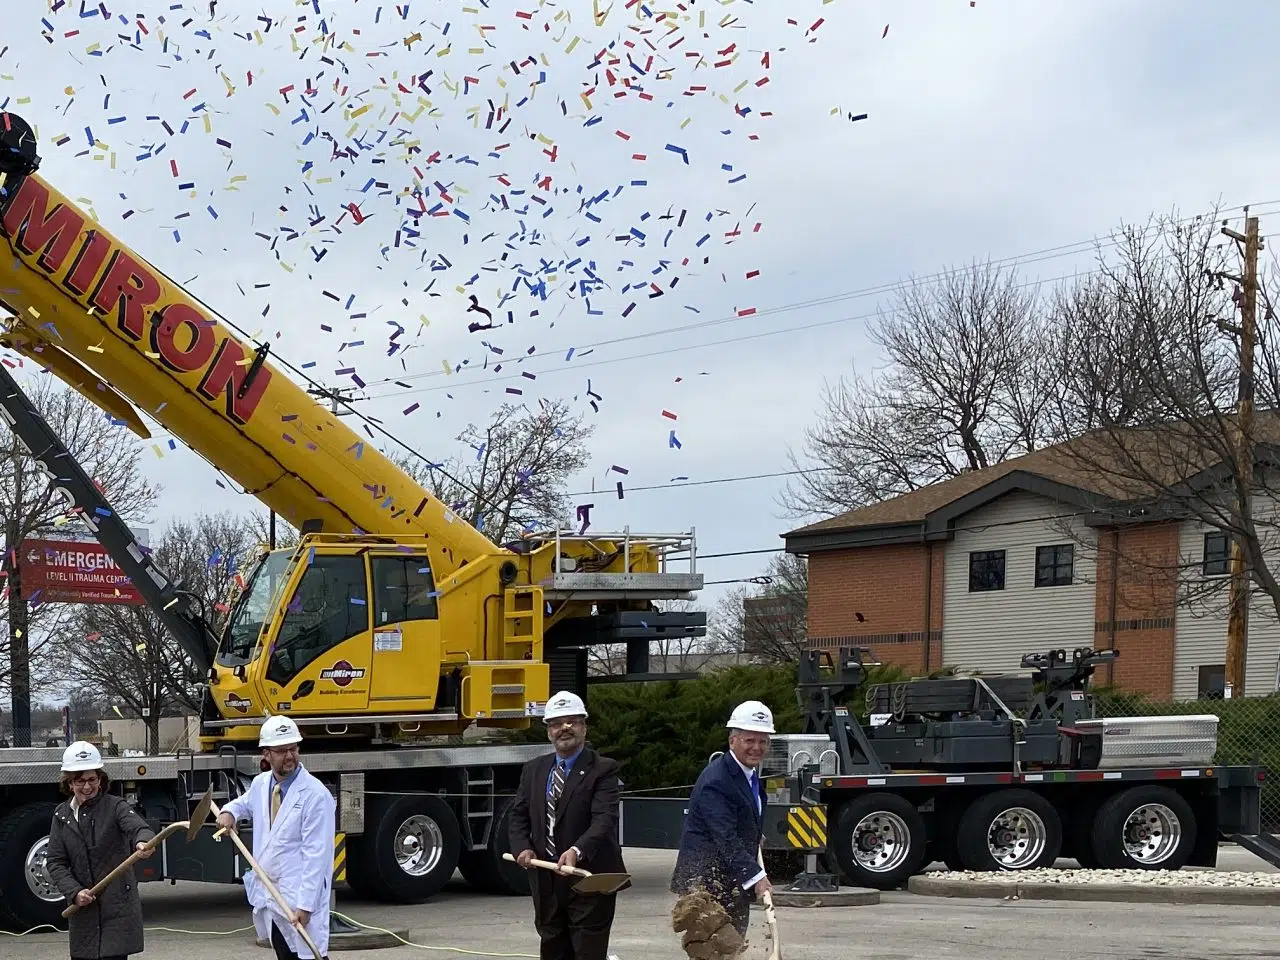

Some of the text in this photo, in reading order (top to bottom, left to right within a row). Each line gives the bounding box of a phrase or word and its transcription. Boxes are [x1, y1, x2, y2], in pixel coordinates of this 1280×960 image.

[45, 550, 121, 570] EMERGEN
[46, 571, 68, 581] LEVEL
[74, 573, 105, 583] TRAUMA
